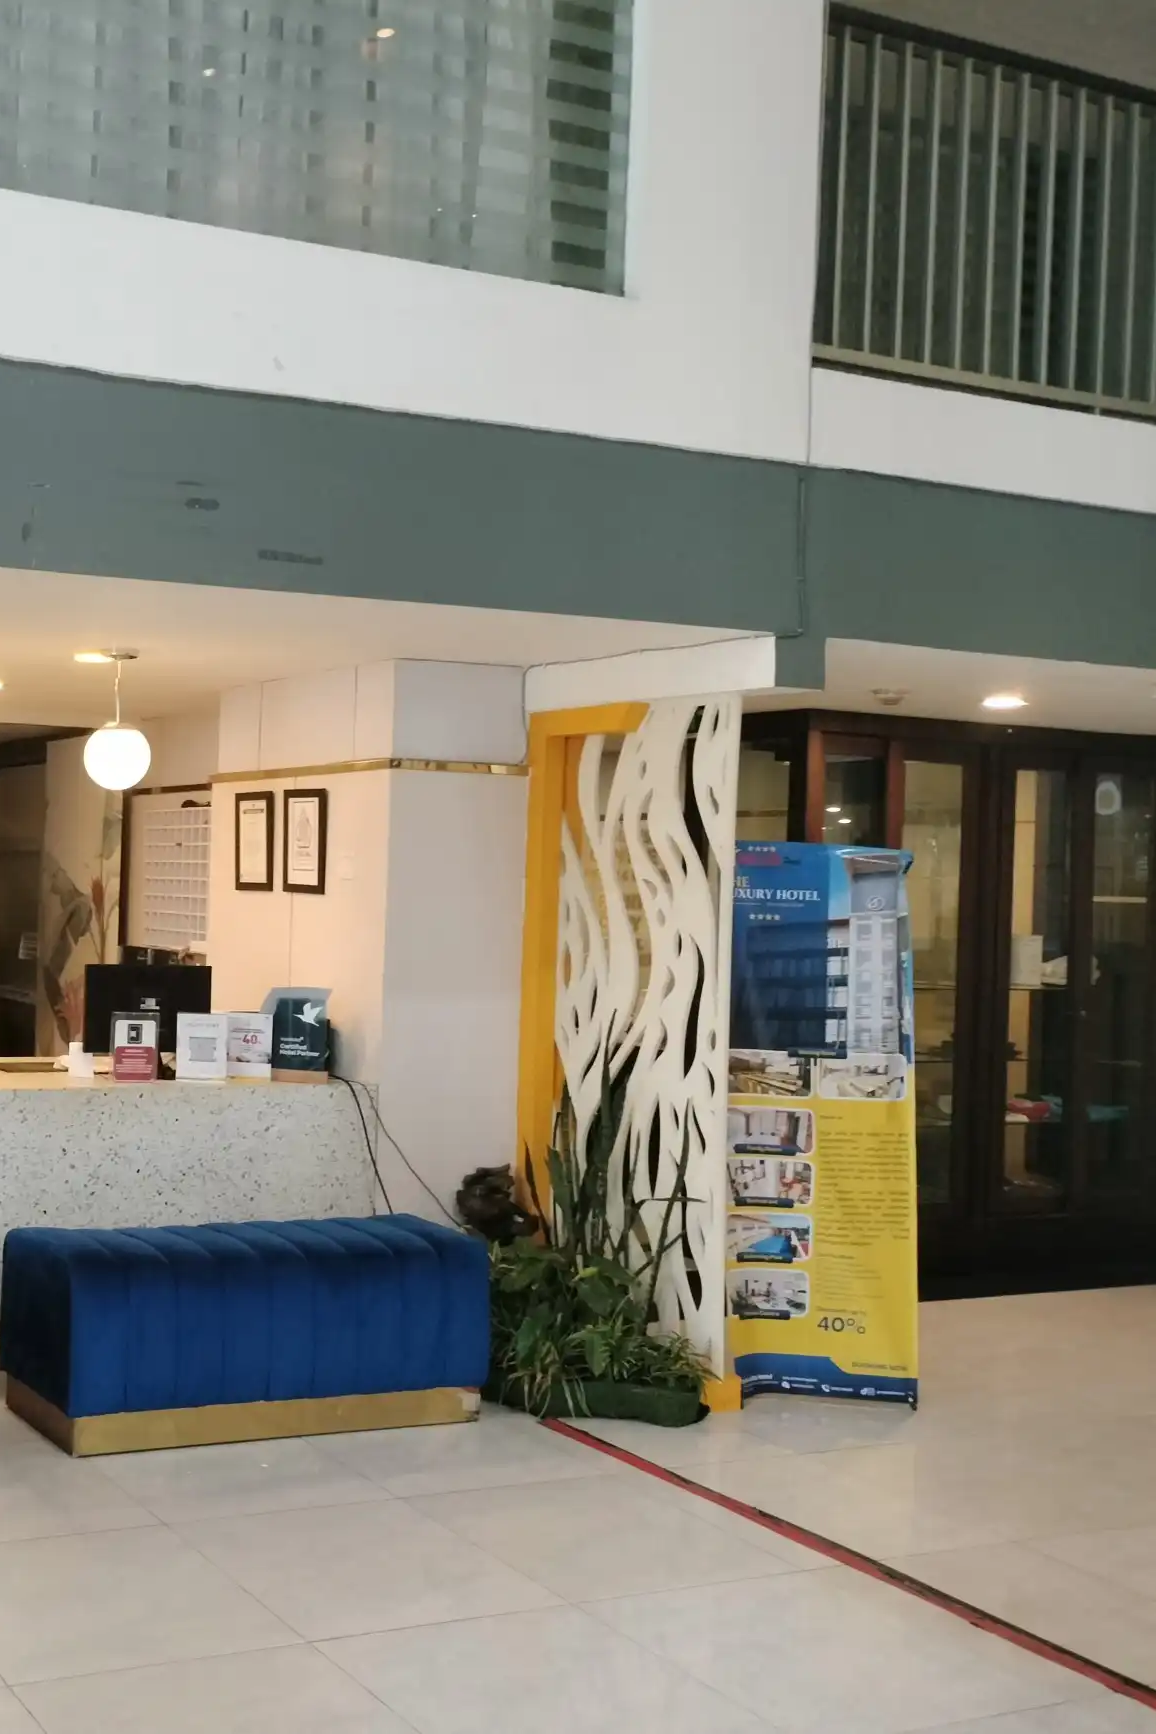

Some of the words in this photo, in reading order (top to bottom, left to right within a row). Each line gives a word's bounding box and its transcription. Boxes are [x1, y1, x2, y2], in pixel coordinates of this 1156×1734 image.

[733, 887, 774, 900] UXURY
[776, 889, 821, 901] HOTEL
[817, 1316, 866, 1335] 40%
